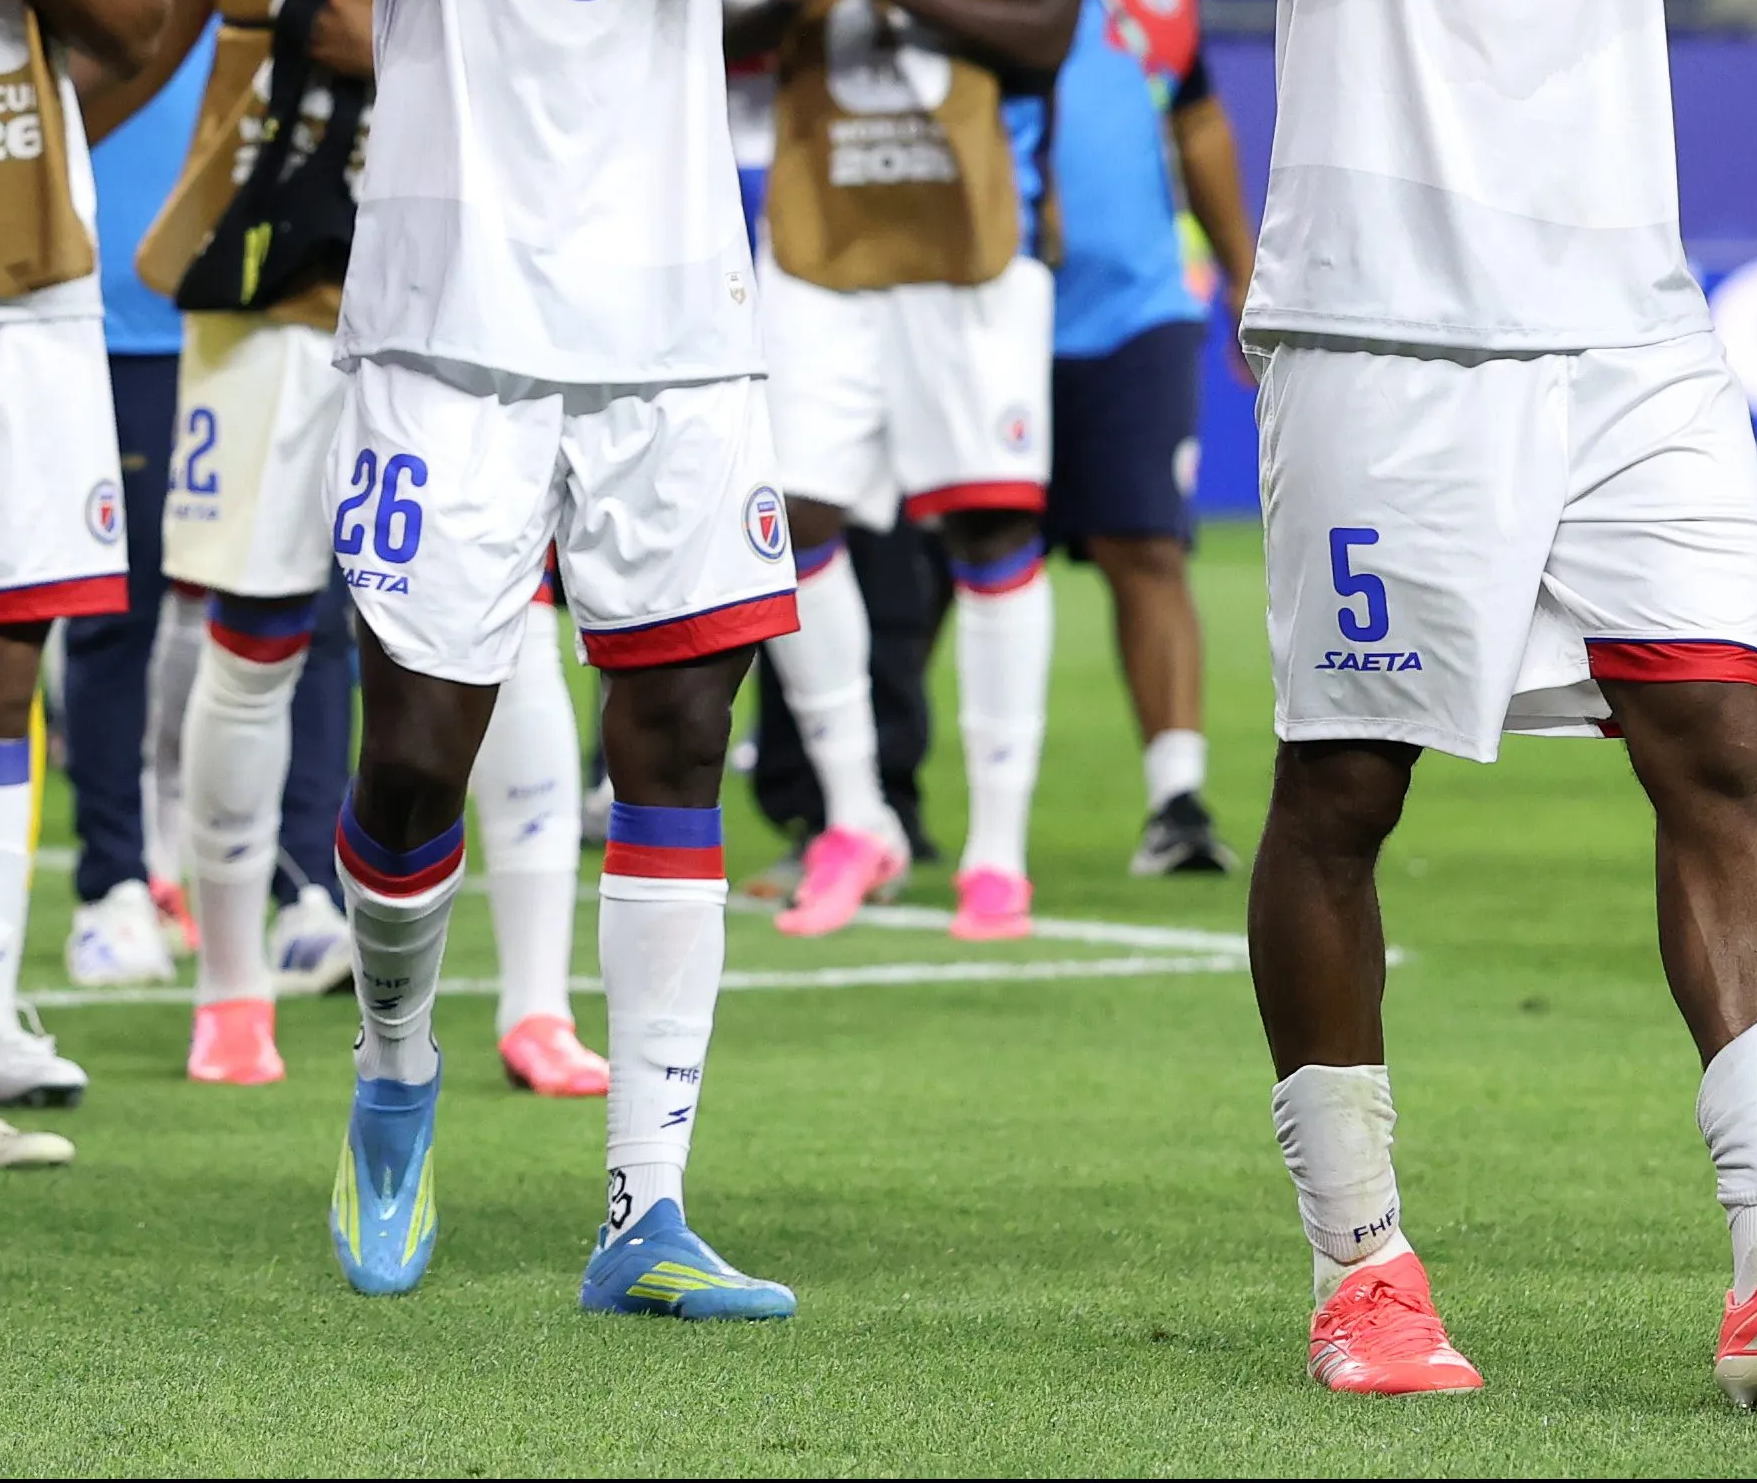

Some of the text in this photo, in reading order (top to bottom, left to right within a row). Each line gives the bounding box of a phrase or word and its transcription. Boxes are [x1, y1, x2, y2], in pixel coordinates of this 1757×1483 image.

[333, 448, 428, 564] 26
[1329, 527, 1390, 643] 5
[1314, 651, 1423, 672] SAETA
[1353, 1206, 1396, 1244] FHF
